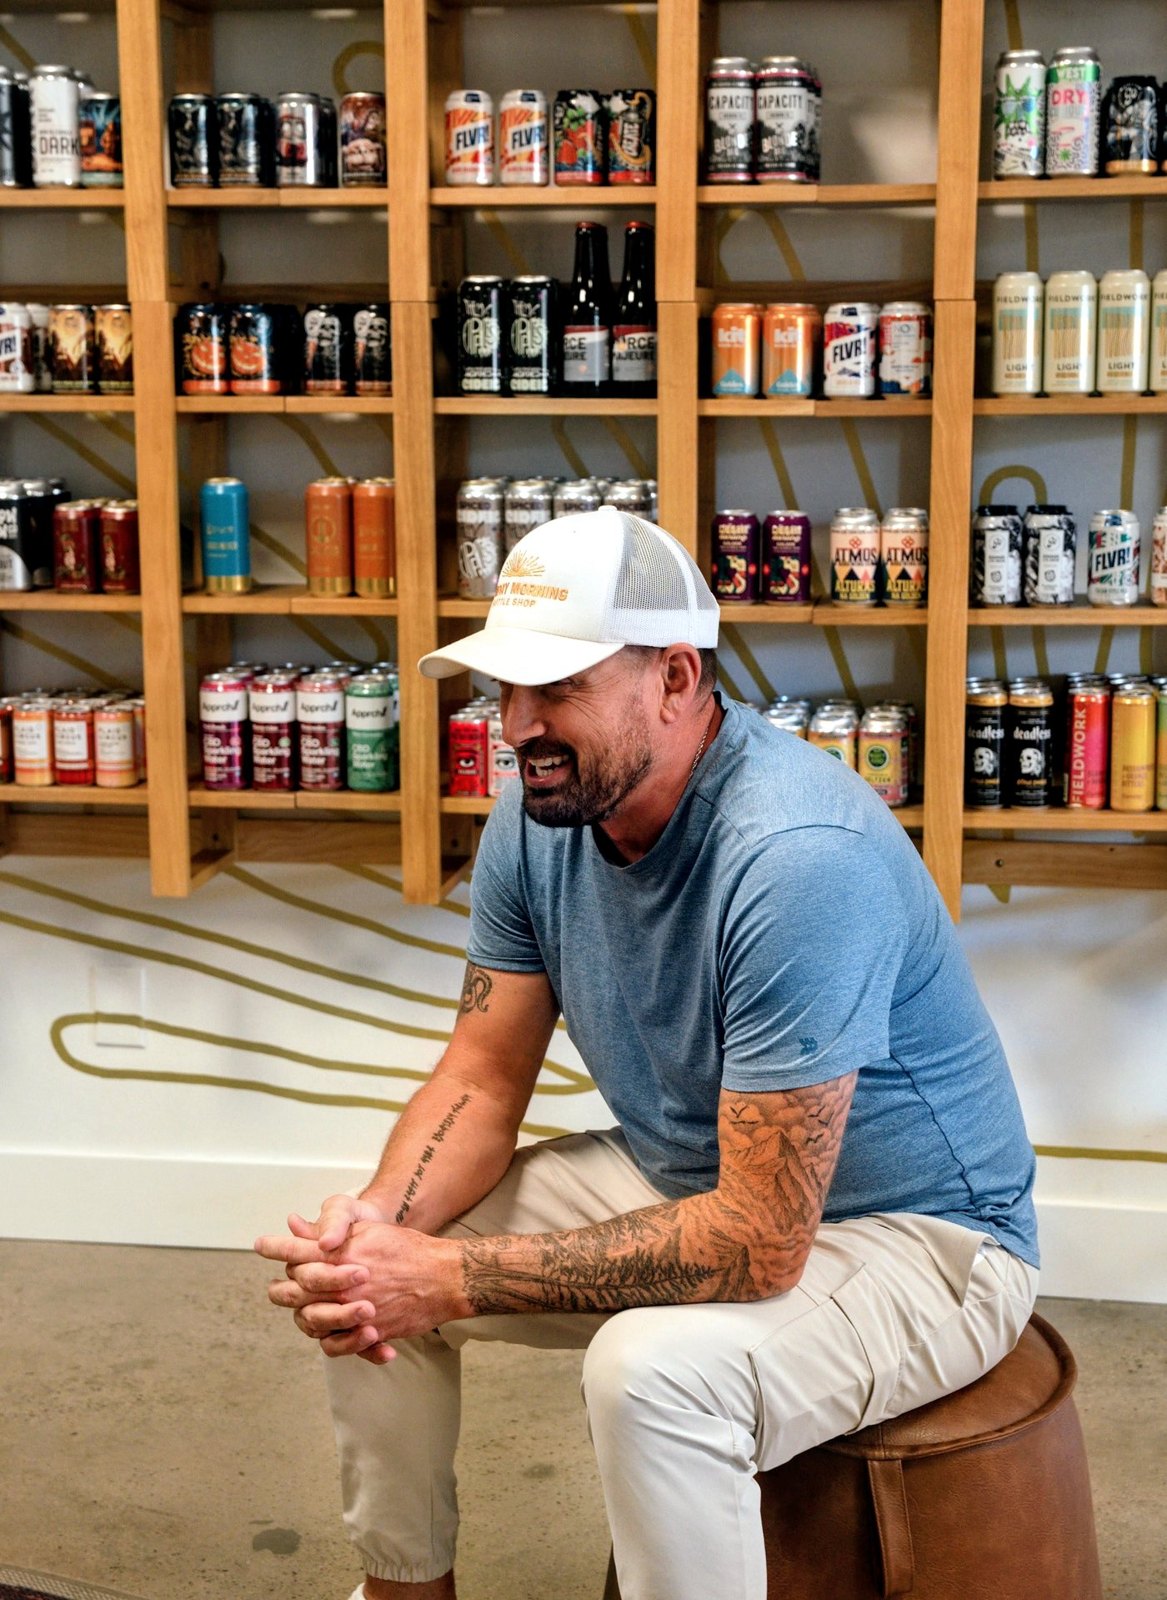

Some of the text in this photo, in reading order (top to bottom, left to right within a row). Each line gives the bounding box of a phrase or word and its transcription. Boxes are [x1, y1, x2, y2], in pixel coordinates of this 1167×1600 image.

[758, 95, 802, 109] CAPACITY
[1052, 88, 1085, 105] DRY
[39, 137, 80, 155] DARK
[833, 338, 867, 363] FLVR!
[835, 548, 877, 562] ATMOS
[886, 548, 928, 562] ATMOS
[1095, 547, 1131, 571] FLVR!
[510, 582, 568, 601] MORNING
[512, 598, 536, 608] SHOP
[1072, 707, 1087, 803] FIELDWORK
